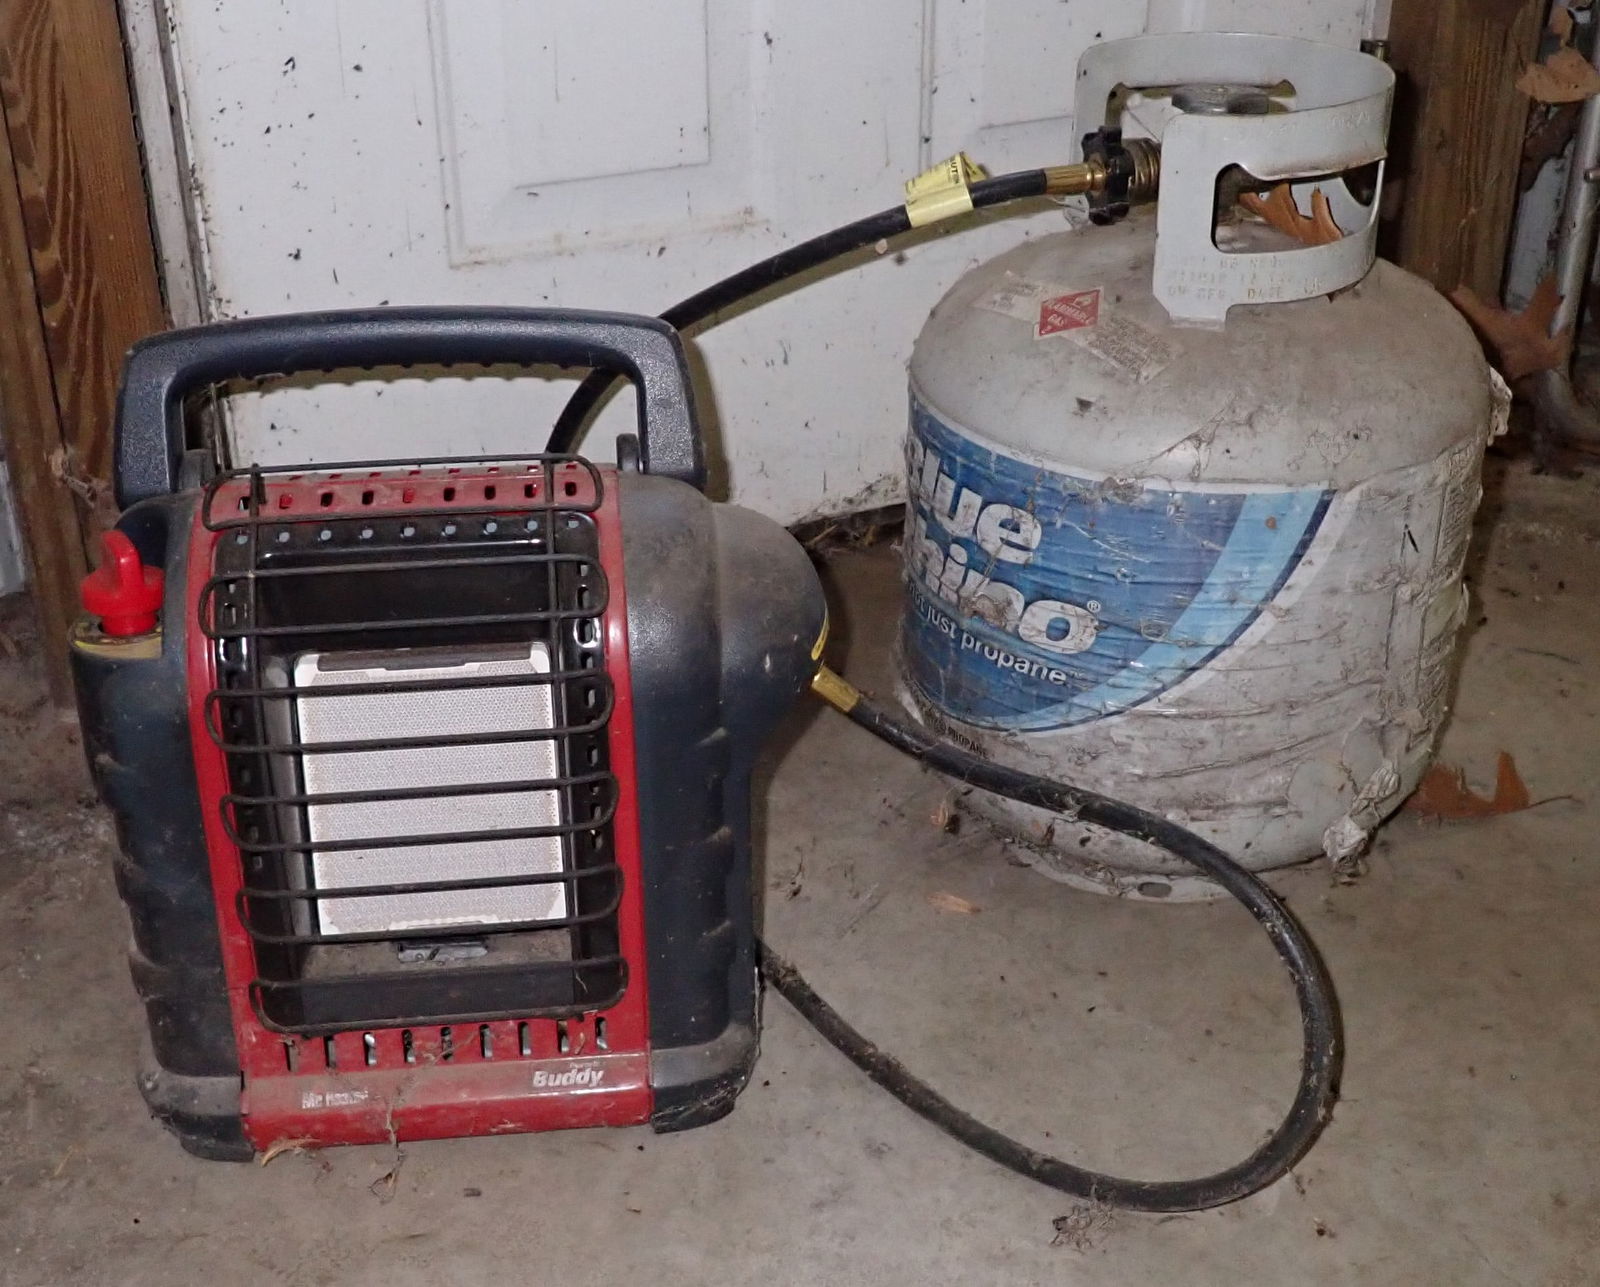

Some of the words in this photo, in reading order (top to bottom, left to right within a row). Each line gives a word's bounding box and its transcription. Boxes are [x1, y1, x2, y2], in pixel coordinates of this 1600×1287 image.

[927, 604, 959, 640] just
[961, 631, 1067, 685] propane
[532, 1067, 604, 1088] Buddy
